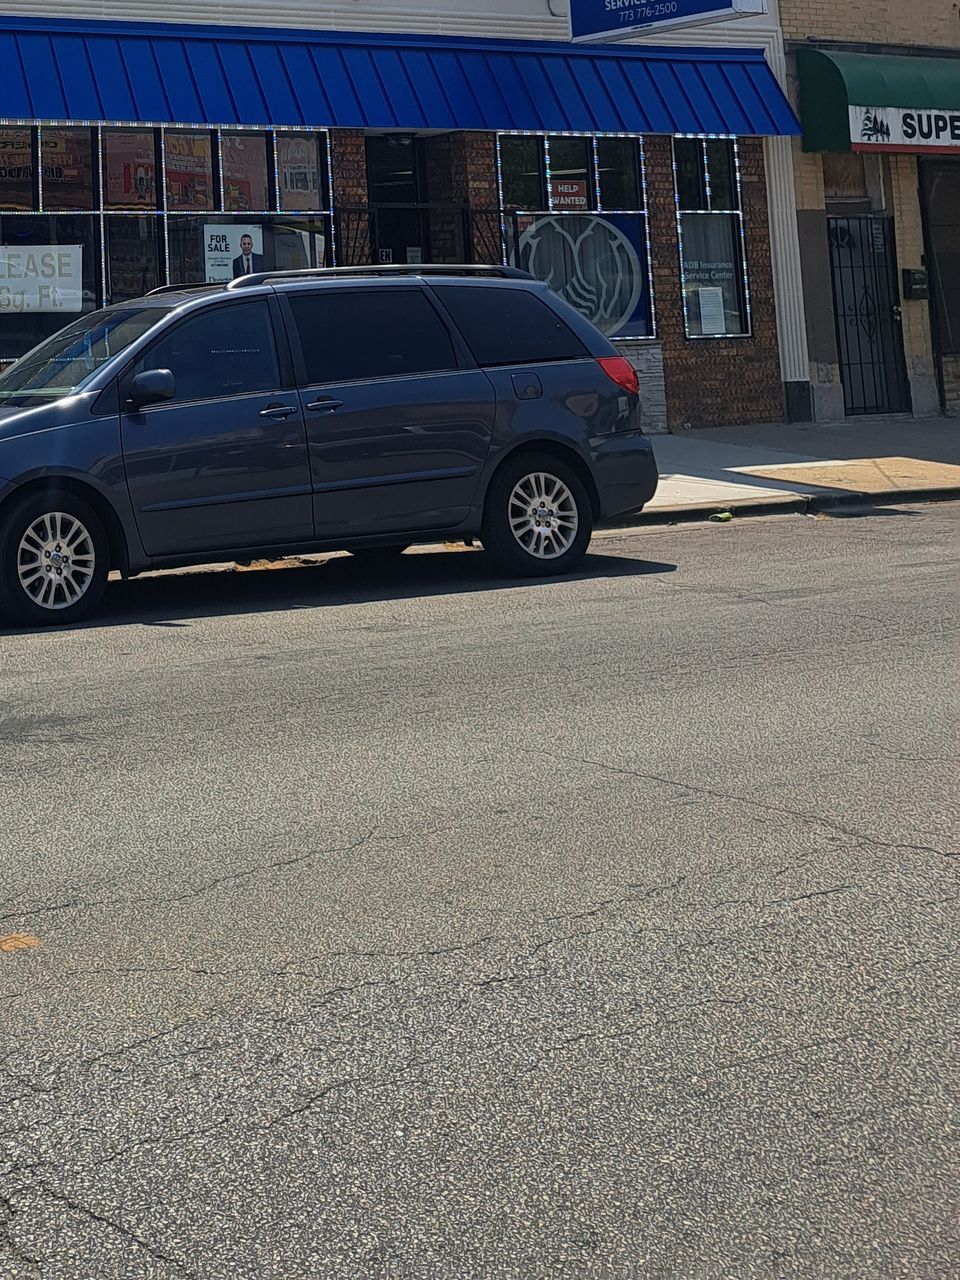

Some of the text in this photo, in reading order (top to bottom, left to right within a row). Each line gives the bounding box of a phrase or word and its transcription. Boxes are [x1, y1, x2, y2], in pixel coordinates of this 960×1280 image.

[618, 1, 678, 23] 773 776-2500
[557, 184, 579, 193] HELP
[552, 196, 586, 205] WANTED
[210, 234, 228, 243] FOR
[208, 243, 230, 252] SALE
[700, 261, 733, 269] Insurance
[685, 271, 734, 280] Service Center
[38, 285, 64, 308] Ft.
